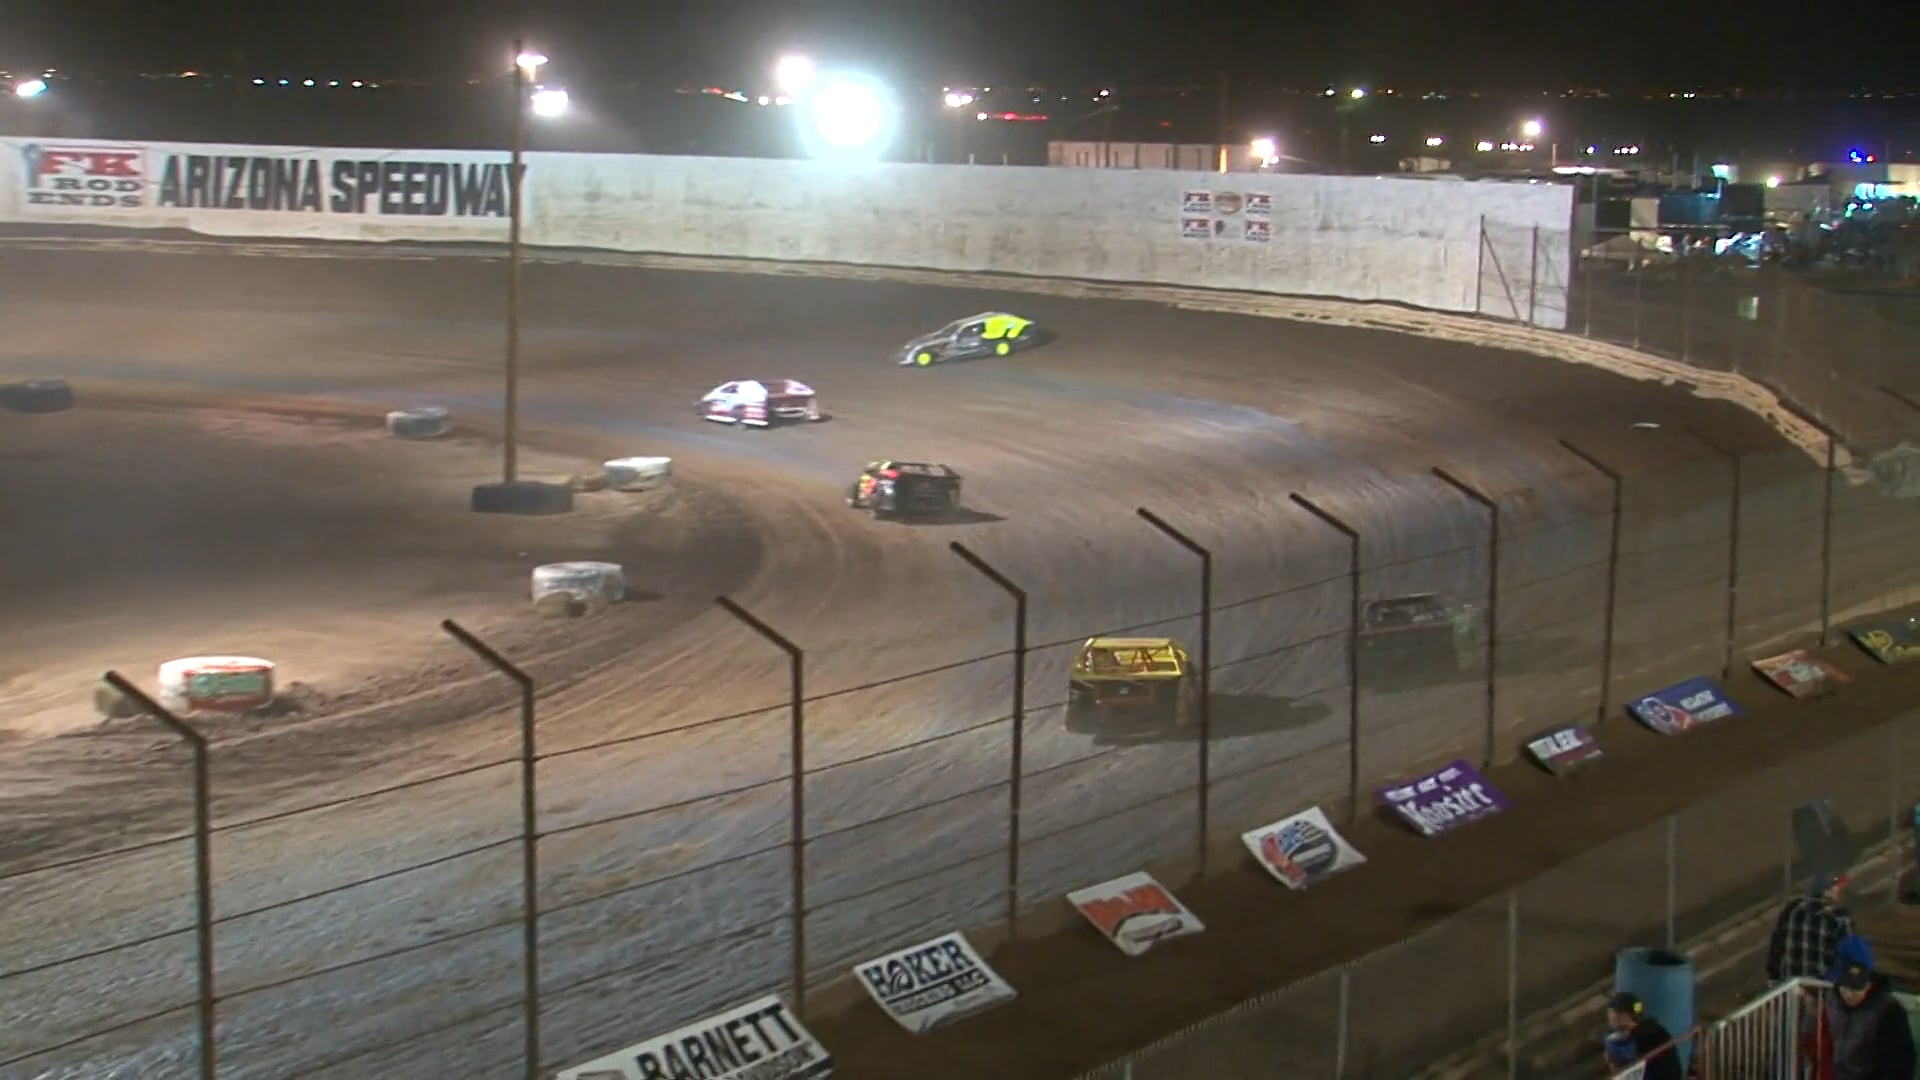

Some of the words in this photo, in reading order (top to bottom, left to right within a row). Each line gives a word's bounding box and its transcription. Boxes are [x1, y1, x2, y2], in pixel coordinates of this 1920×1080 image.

[27, 191, 144, 207] ENDS
[52, 177, 144, 192] ROD
[158, 155, 323, 212] ARIZONA
[330, 160, 526, 217] SPEEDWAY
[635, 1002, 800, 1080] BARNETT
